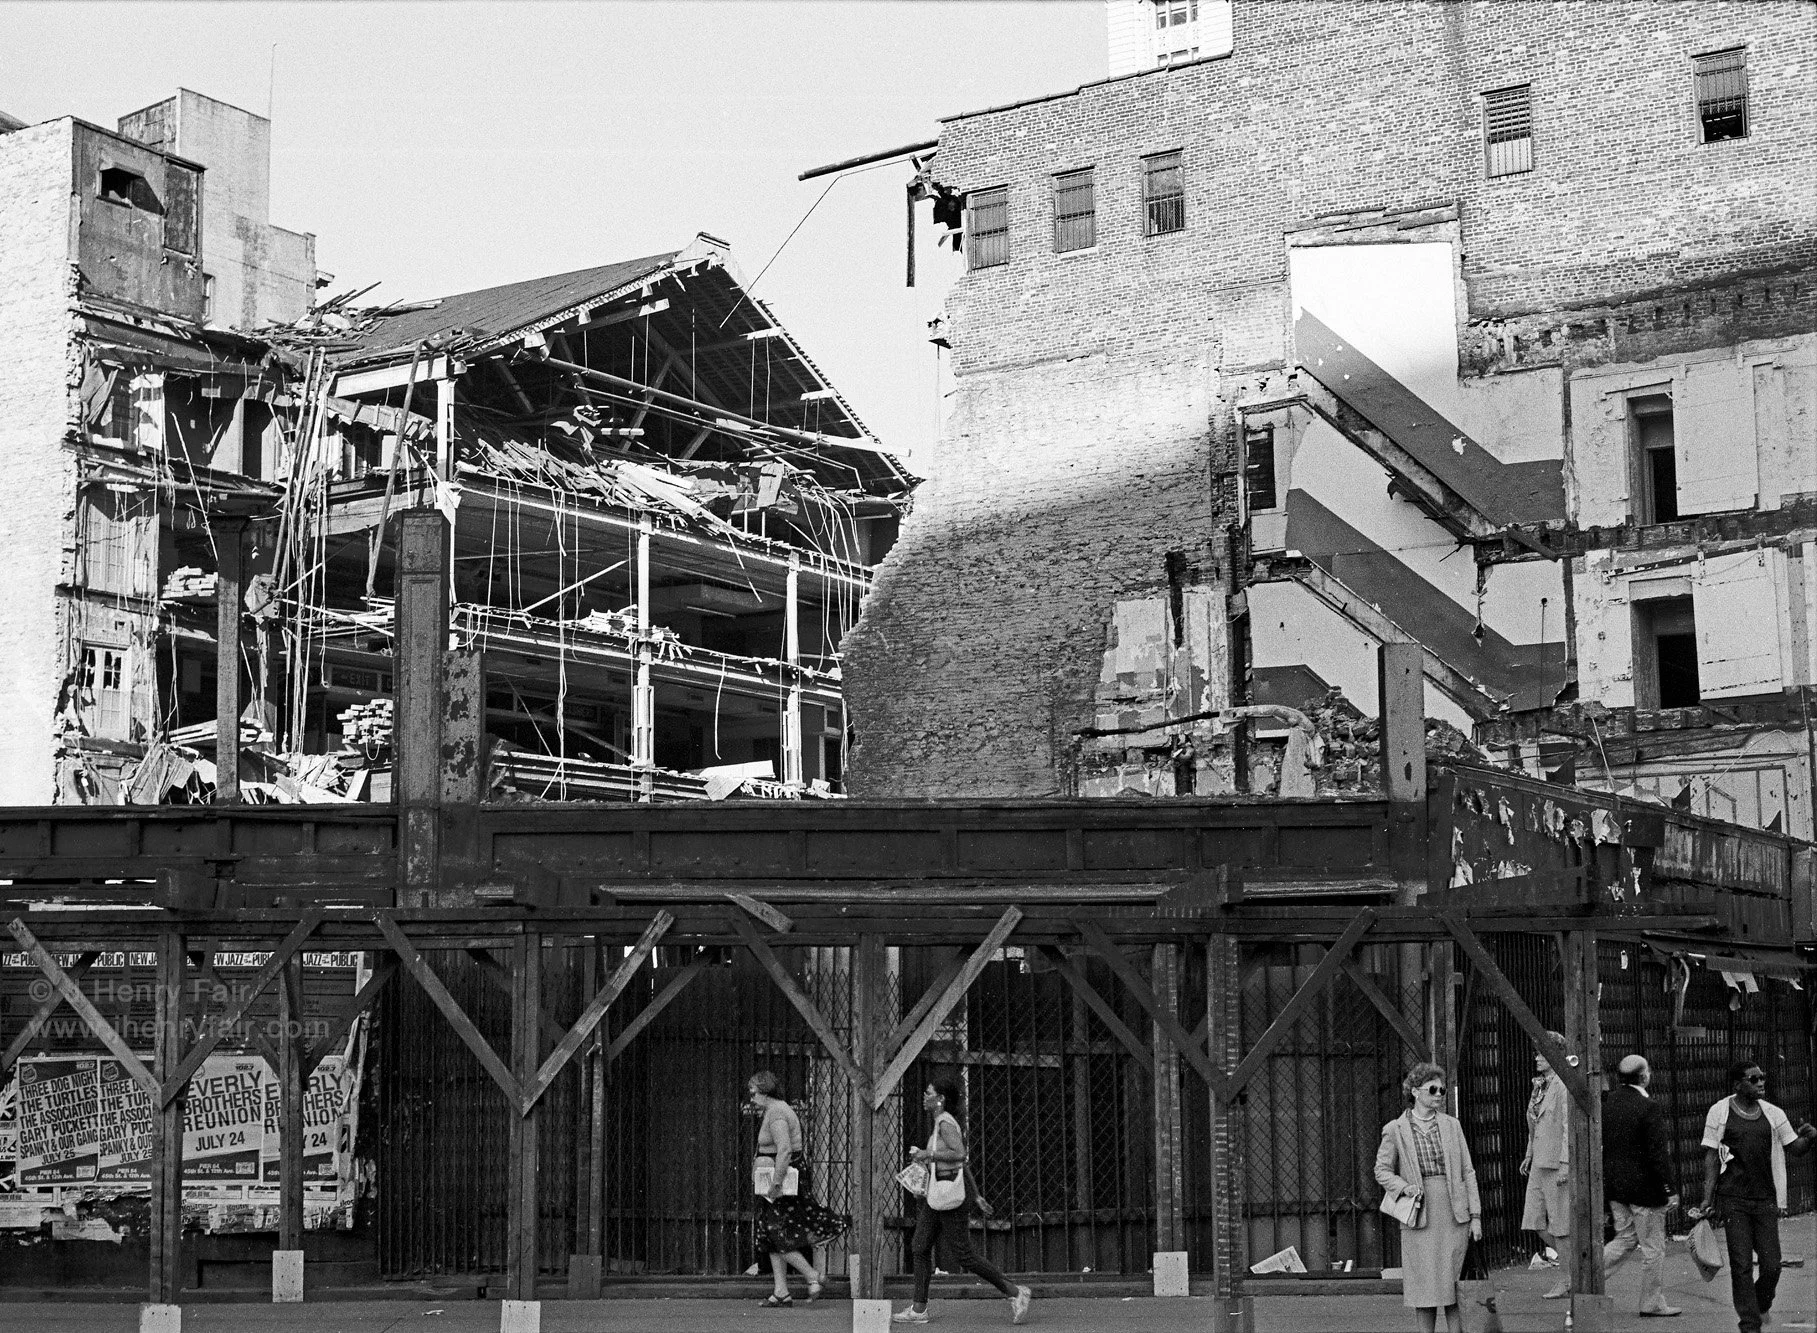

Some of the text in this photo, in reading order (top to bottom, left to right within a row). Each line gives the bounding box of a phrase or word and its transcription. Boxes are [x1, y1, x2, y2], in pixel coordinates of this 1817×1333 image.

[96, 953, 124, 967] PUBLIC
[130, 953, 148, 966] NEW
[225, 953, 244, 966] JAZZ
[303, 953, 321, 967] JAZZ
[330, 954, 358, 967] PUBLIC
[20, 1082, 50, 1100] THREE
[51, 1077, 70, 1093] DOG
[71, 1071, 97, 1088] NIGHT
[100, 1080, 130, 1098] THREE
[187, 1070, 262, 1098] EVERLY
[20, 1085, 98, 1114] THE TURTLES
[100, 1096, 123, 1112] THE
[184, 1088, 262, 1115] BROTHERS
[20, 1113, 38, 1129] THE
[40, 1100, 98, 1125] ASSOCIATION
[100, 1105, 152, 1127] THE ASSOCI
[183, 1106, 261, 1132] REUNION
[20, 1125, 47, 1144] GARY
[51, 1114, 98, 1137] PUCKETT
[100, 1123, 127, 1141] GARY
[20, 1140, 49, 1159] SPANKY
[51, 1138, 58, 1152] &
[58, 1134, 75, 1150] OUR
[76, 1129, 98, 1146] GANG
[100, 1138, 128, 1157] SPANKY
[130, 1137, 136, 1151] &
[195, 1131, 245, 1152] JULY 24
[311, 1132, 327, 1147] 24
[42, 1149, 75, 1165] JULY 25
[120, 1148, 152, 1163] JULY 25
